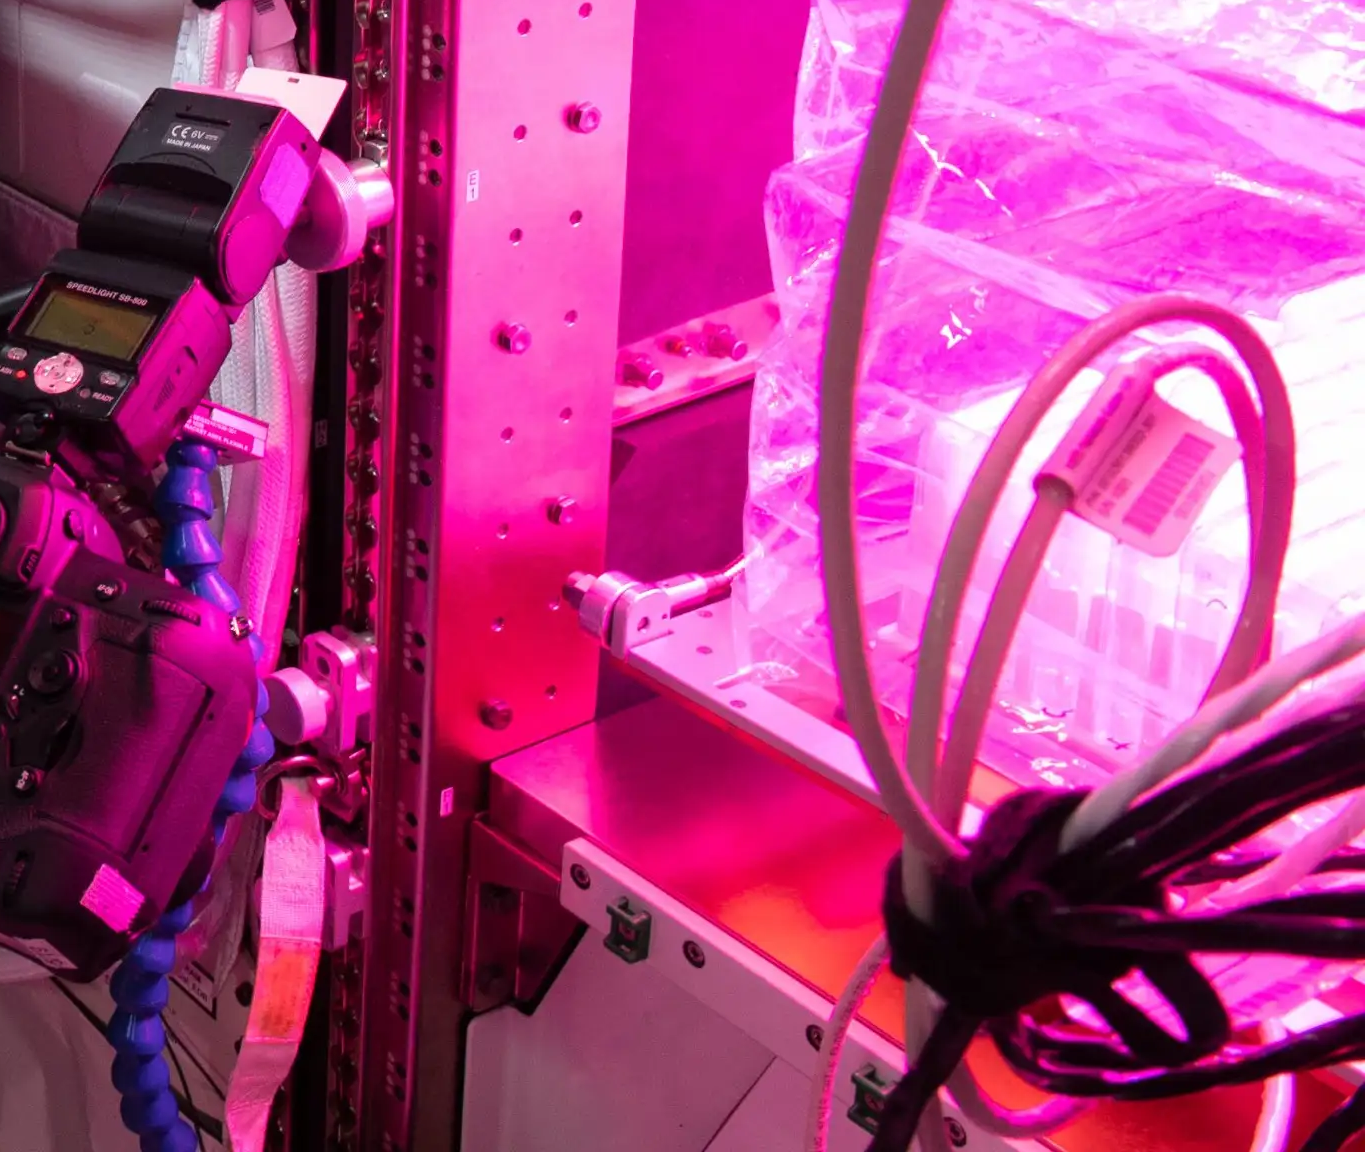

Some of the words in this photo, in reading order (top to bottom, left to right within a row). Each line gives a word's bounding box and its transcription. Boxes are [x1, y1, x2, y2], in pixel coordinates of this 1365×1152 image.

[166, 137, 183, 147] MADE
[190, 141, 212, 151] JAPAN
[66, 280, 120, 300] SPEEDLIGHT
[92, 391, 115, 404] READY
